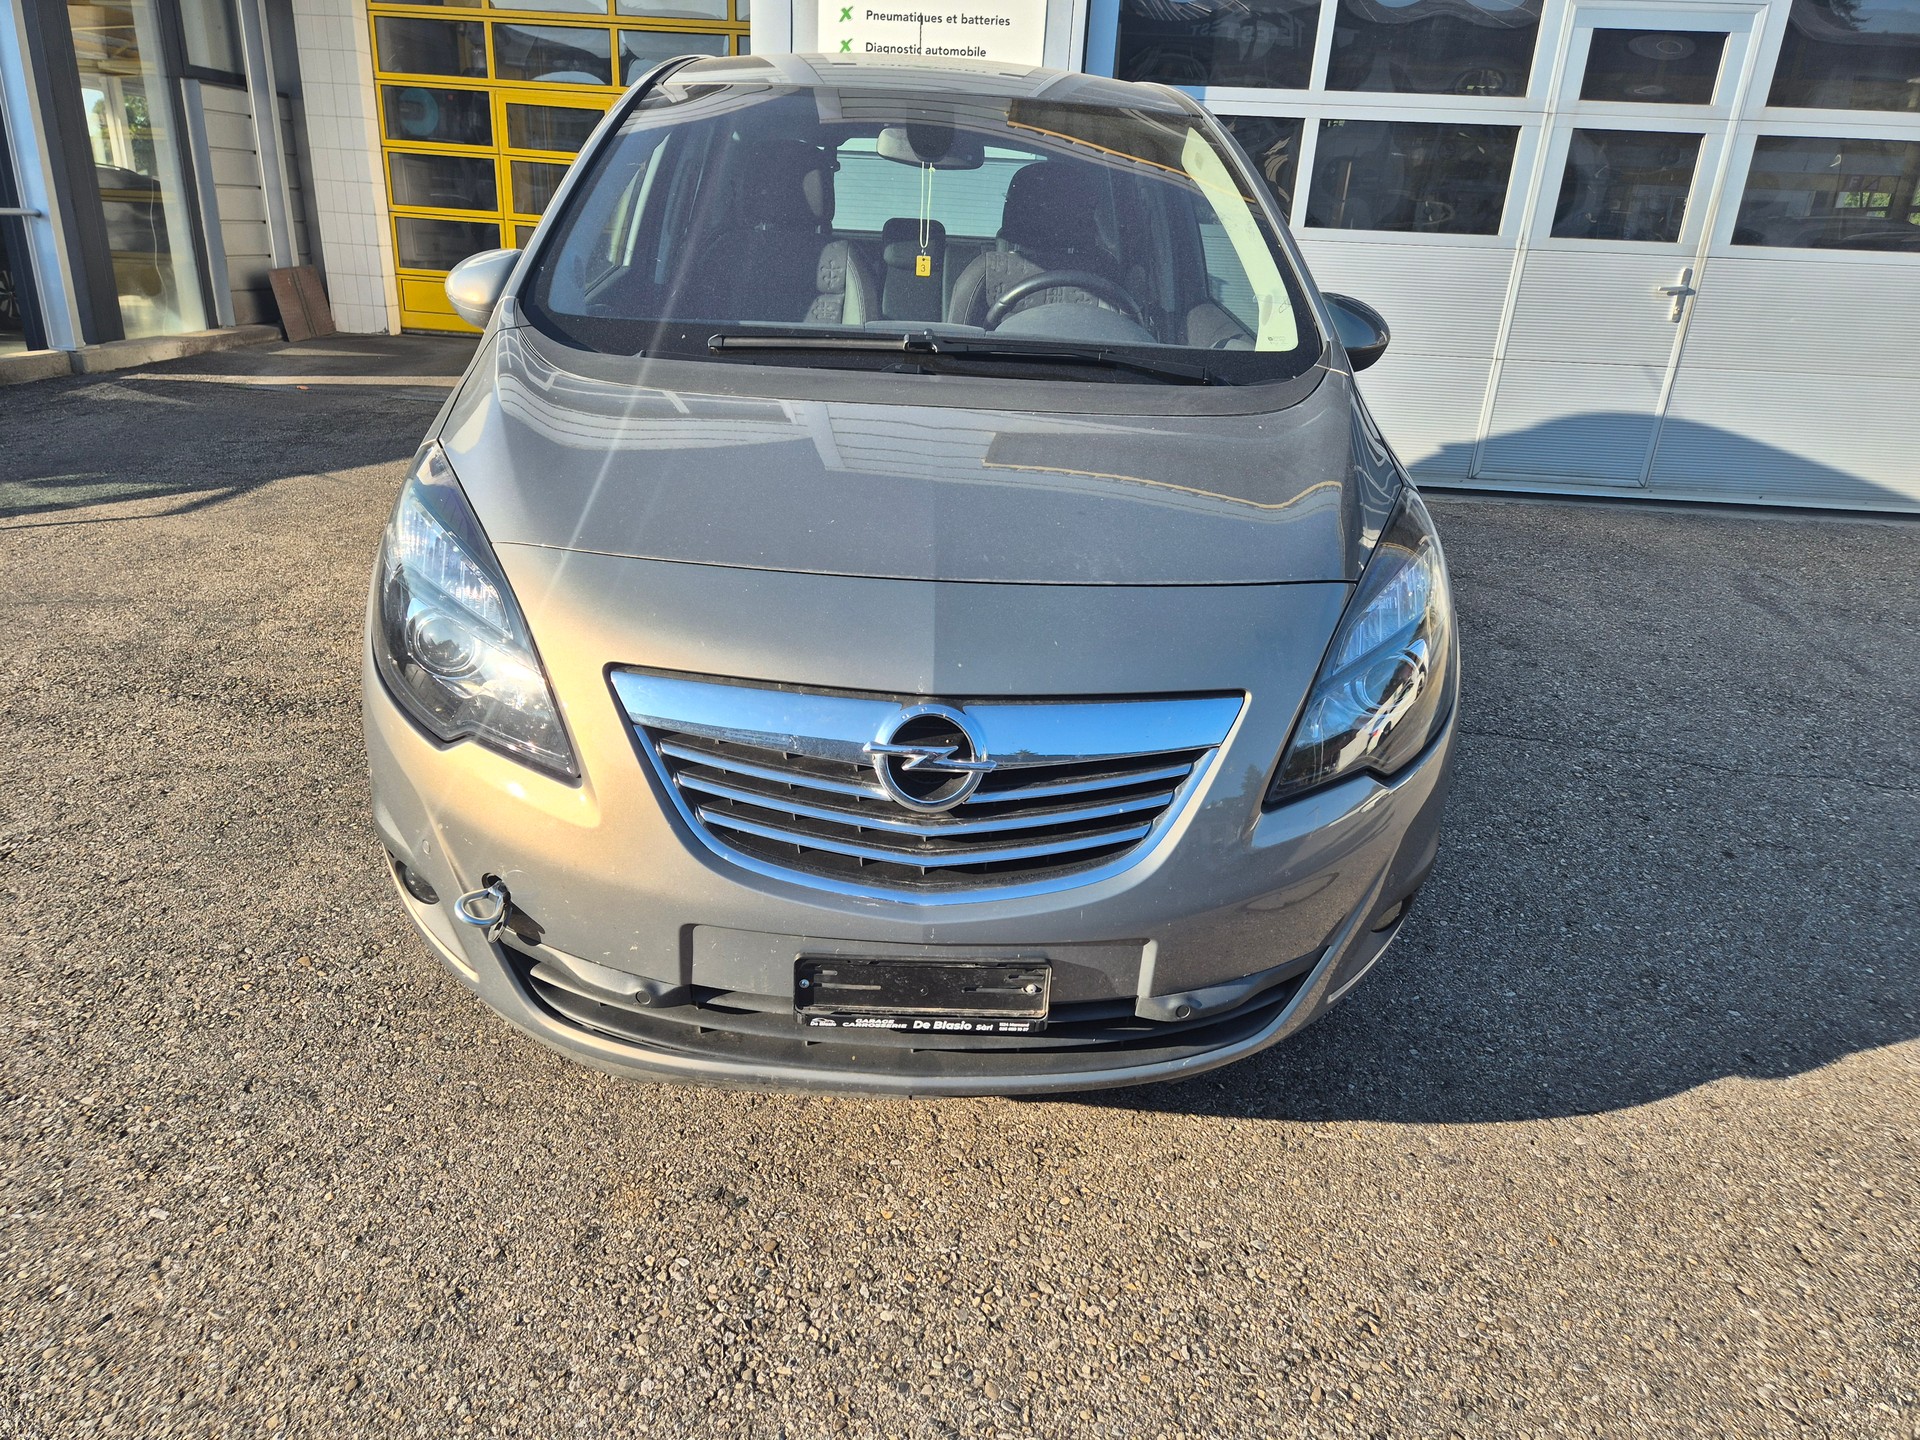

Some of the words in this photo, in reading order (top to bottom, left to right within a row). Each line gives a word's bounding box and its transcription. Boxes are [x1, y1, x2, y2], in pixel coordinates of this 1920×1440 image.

[866, 9, 942, 26] Pneumatiques
[946, 14, 958, 24] et
[961, 13, 1011, 26] batteries
[865, 42, 922, 55] Diagnostic
[925, 46, 987, 57] automobile
[920, 263, 926, 273] 3
[913, 1020, 930, 1029] De
[933, 1021, 973, 1031] Blasio
